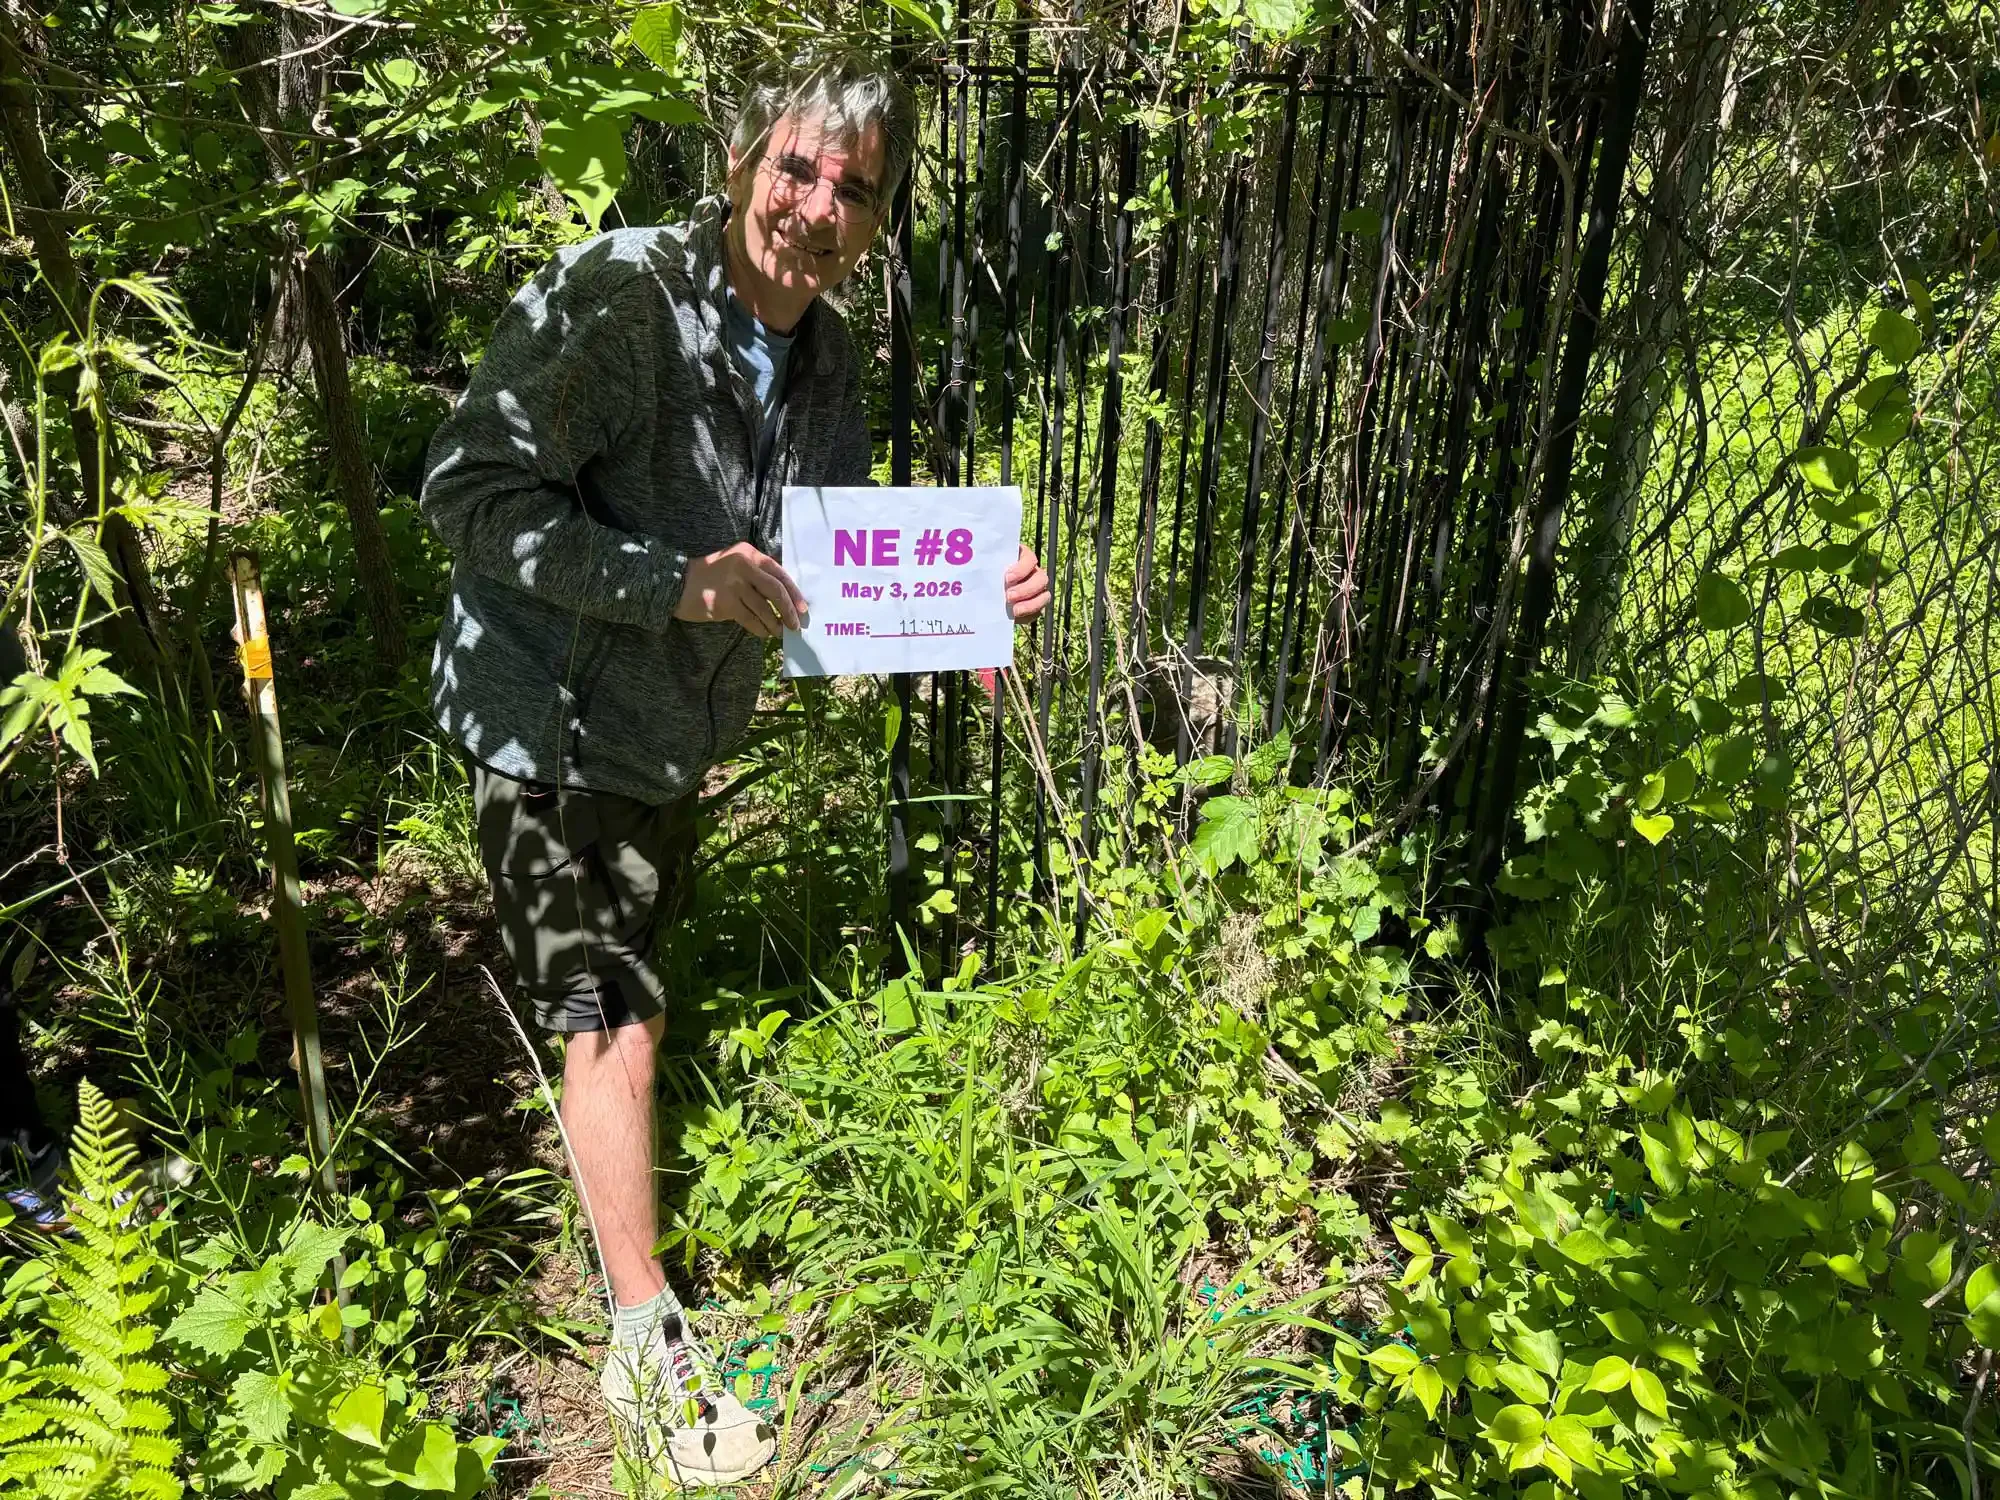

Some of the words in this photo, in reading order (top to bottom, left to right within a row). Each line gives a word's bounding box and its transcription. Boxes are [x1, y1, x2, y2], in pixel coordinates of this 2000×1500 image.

[834, 529, 900, 567] NE
[913, 528, 973, 566] #8
[841, 582, 884, 601] May
[889, 582, 908, 600] 3,
[913, 581, 963, 598] 2026
[824, 623, 871, 637] TIME:
